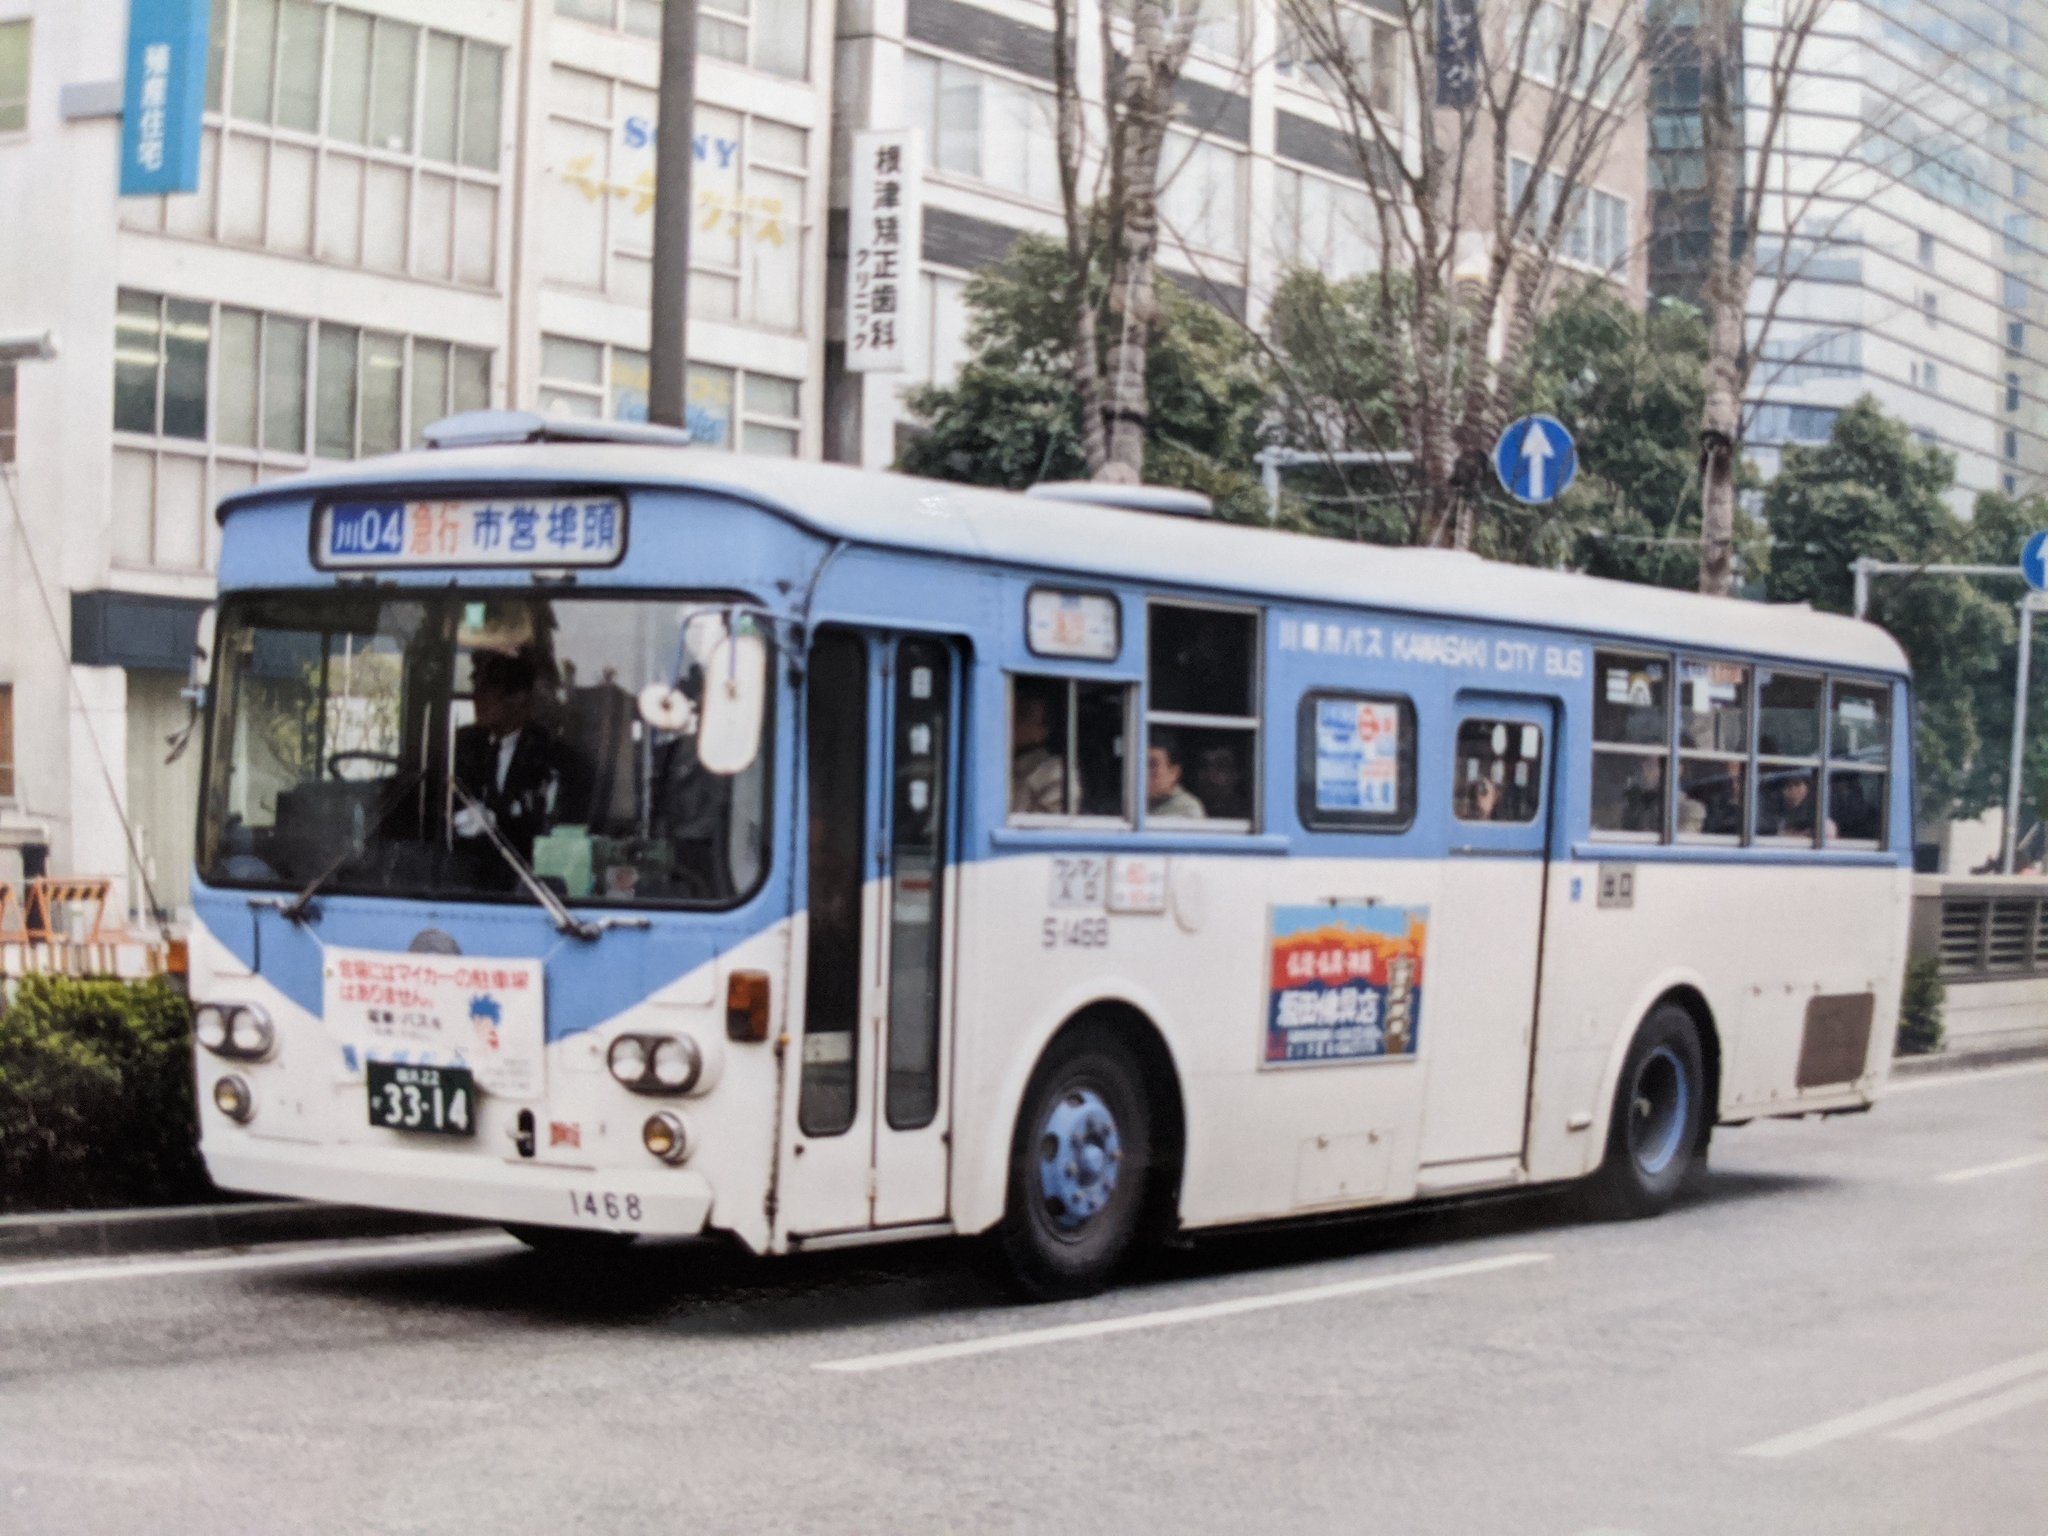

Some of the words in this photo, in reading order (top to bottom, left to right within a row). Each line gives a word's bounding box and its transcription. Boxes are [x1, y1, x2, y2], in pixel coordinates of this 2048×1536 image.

[624, 116, 737, 168] SNY
[1391, 630, 1488, 669] KAWASAKI
[1494, 640, 1538, 673] CITY
[1544, 647, 1585, 680] BUS
[568, 1190, 643, 1220] 1468
